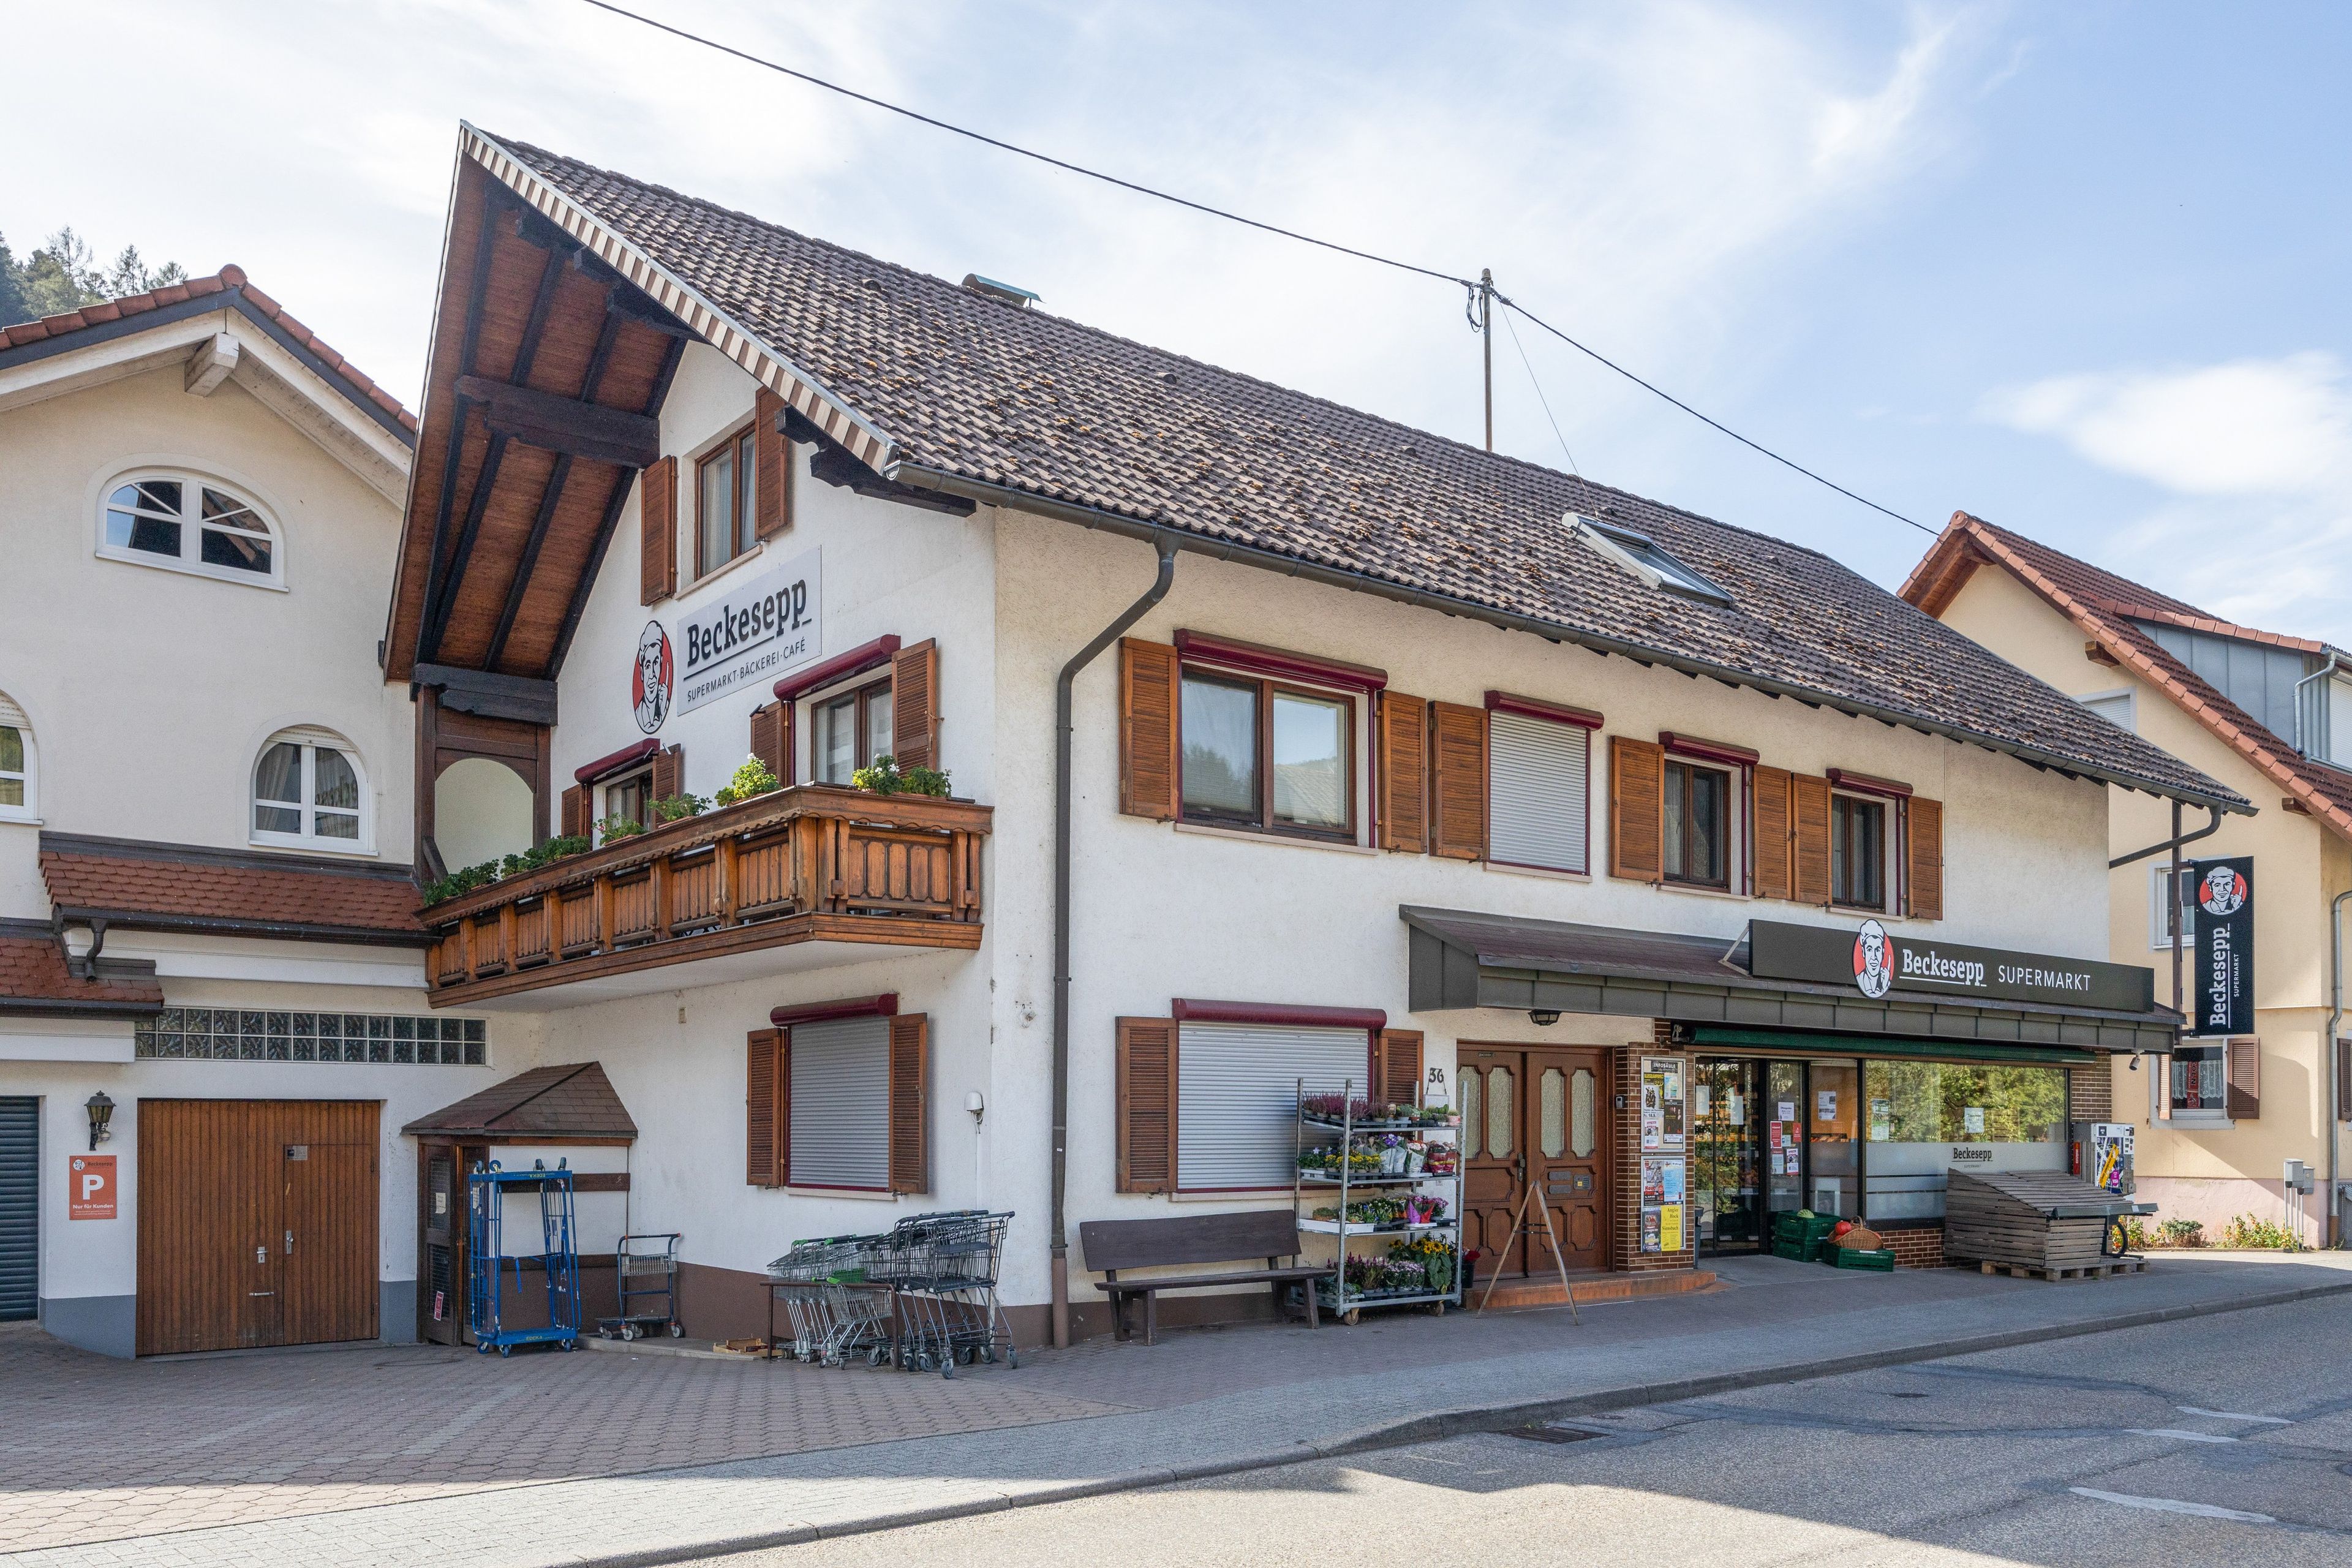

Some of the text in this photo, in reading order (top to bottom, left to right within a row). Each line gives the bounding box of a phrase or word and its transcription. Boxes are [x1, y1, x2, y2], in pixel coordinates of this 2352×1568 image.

[687, 579, 807, 668] Beckesepp
[1902, 948, 2091, 991] Beckesepp SUPERMARKT
[2209, 927, 2230, 1026] Beckesepp
[1429, 1068, 1444, 1084] 36
[1953, 1147, 1992, 1161] Beckesepp
[83, 1174, 104, 1200] P
